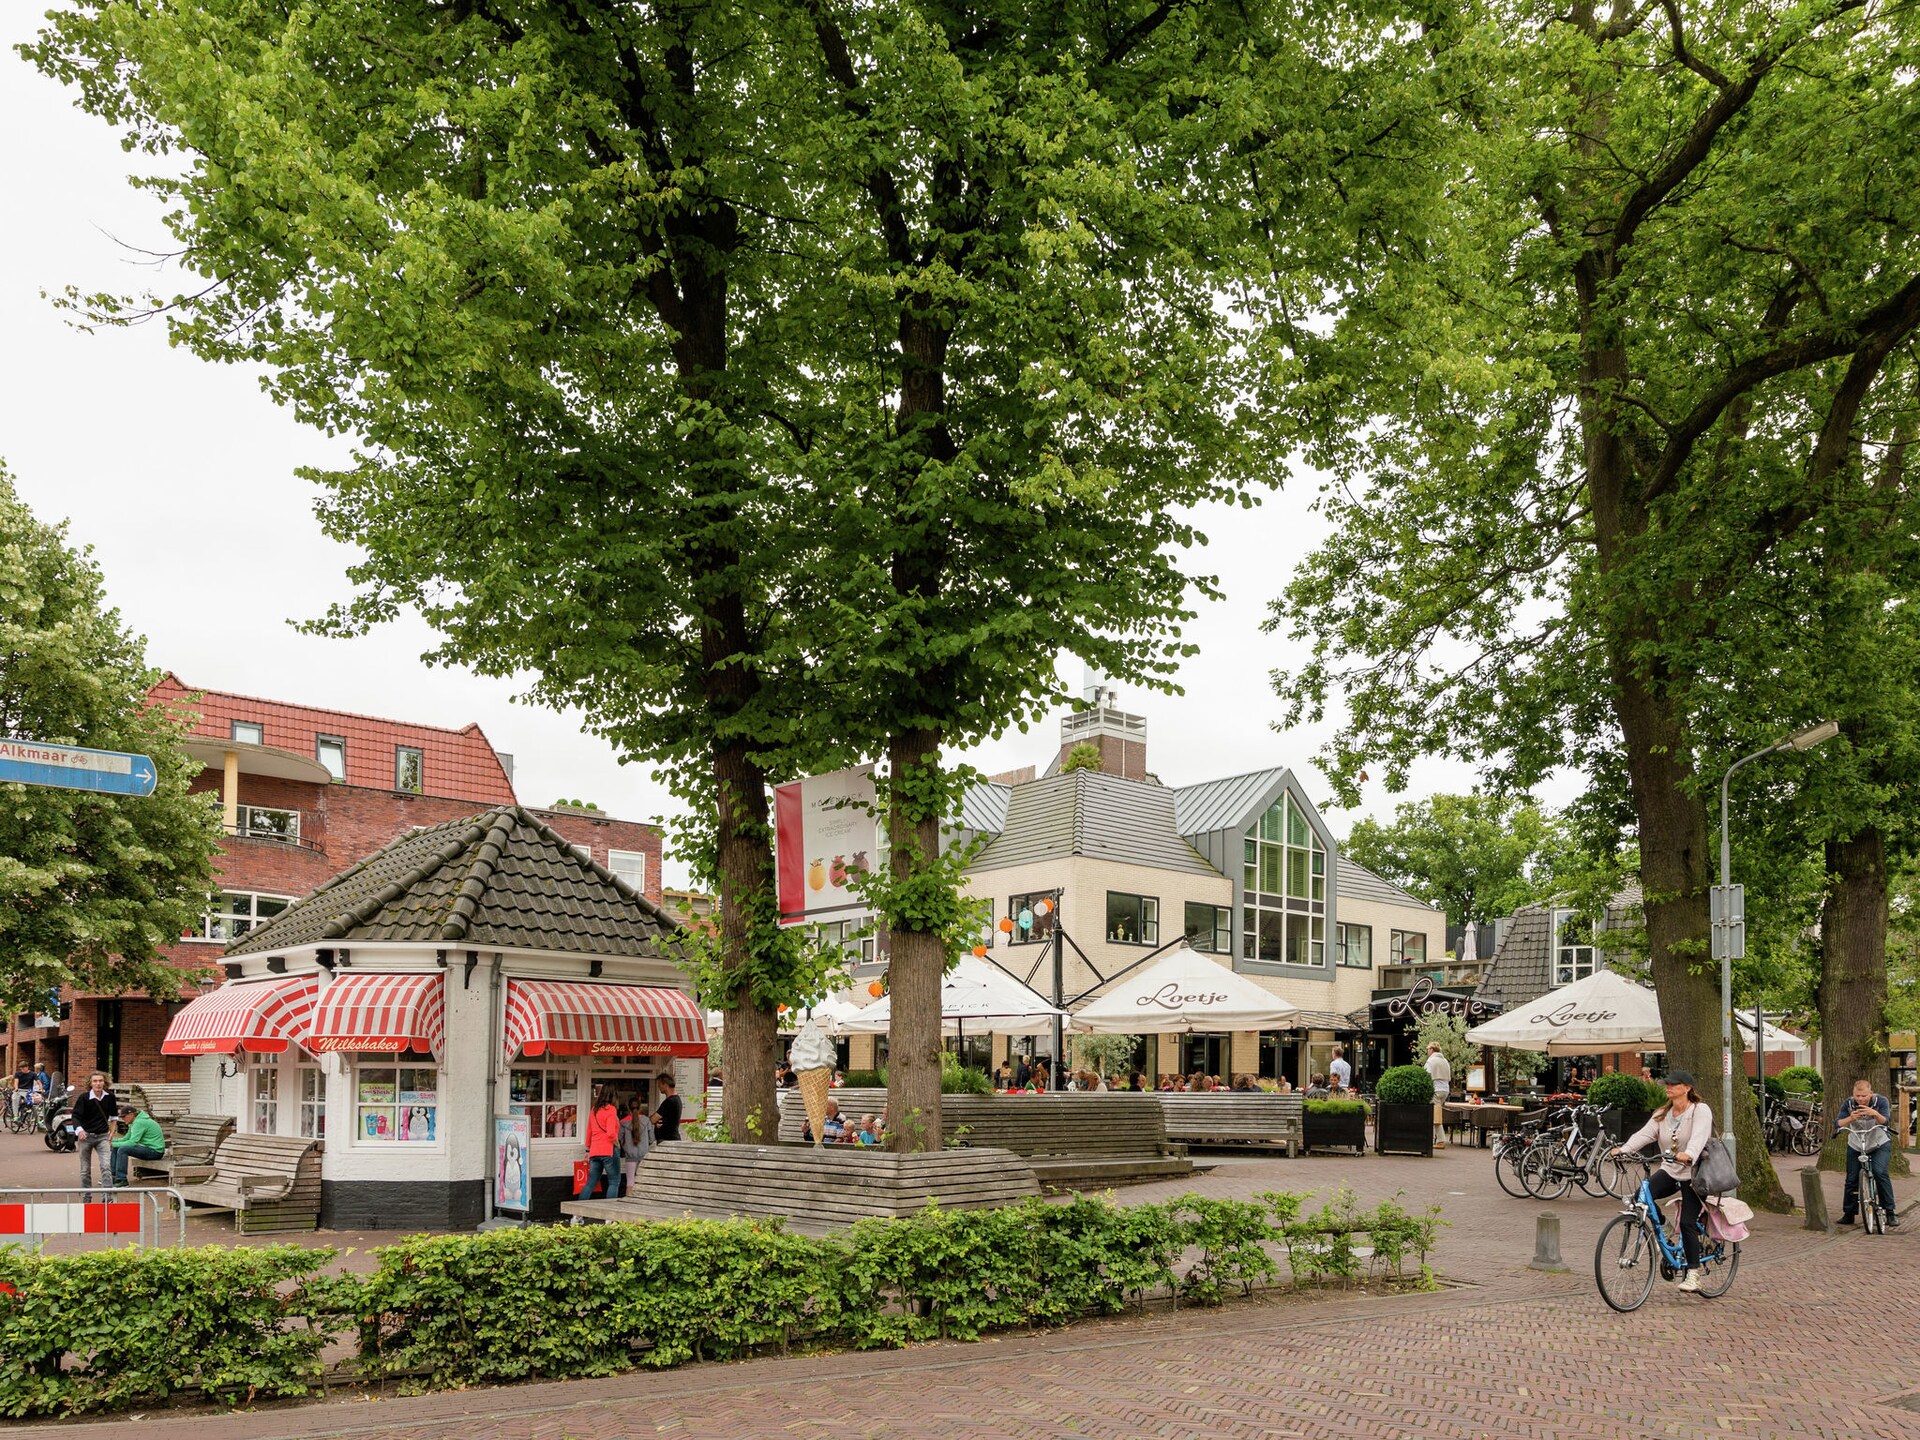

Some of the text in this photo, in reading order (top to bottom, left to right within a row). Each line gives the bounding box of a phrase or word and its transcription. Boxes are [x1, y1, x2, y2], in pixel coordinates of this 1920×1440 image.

[0, 744, 68, 762] Alkmaar
[1136, 983, 1229, 1010] Loetje
[1389, 976, 1484, 1026] Loetje
[1530, 1002, 1617, 1027] Loetje
[318, 1036, 399, 1050] Milkshakes
[591, 1042, 672, 1055] Sandra's ijspaleis
